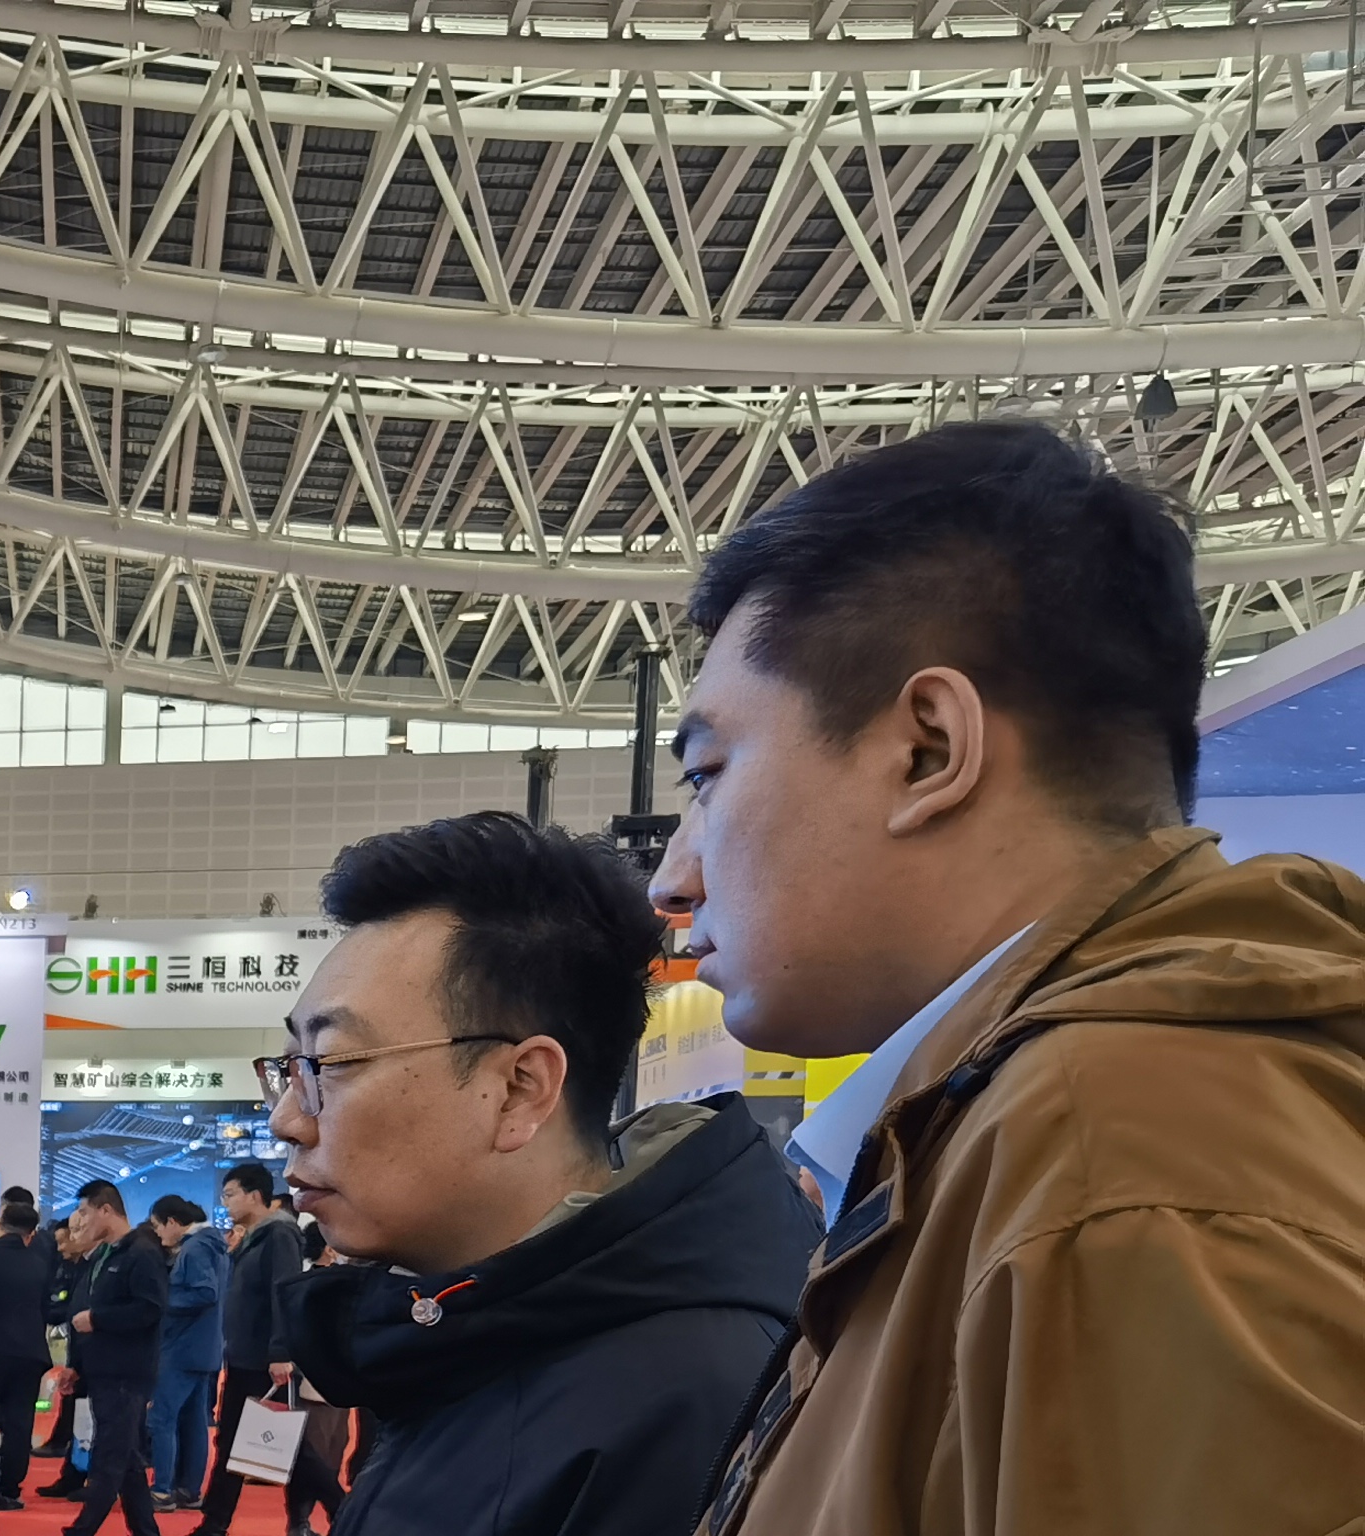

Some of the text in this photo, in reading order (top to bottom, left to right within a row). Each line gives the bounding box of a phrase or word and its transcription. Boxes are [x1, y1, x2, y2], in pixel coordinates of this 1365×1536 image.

[166, 980, 301, 993] SHINE TECHNOLOGY
[53, 1071, 224, 1089] 智慧矿山综合解决方案
